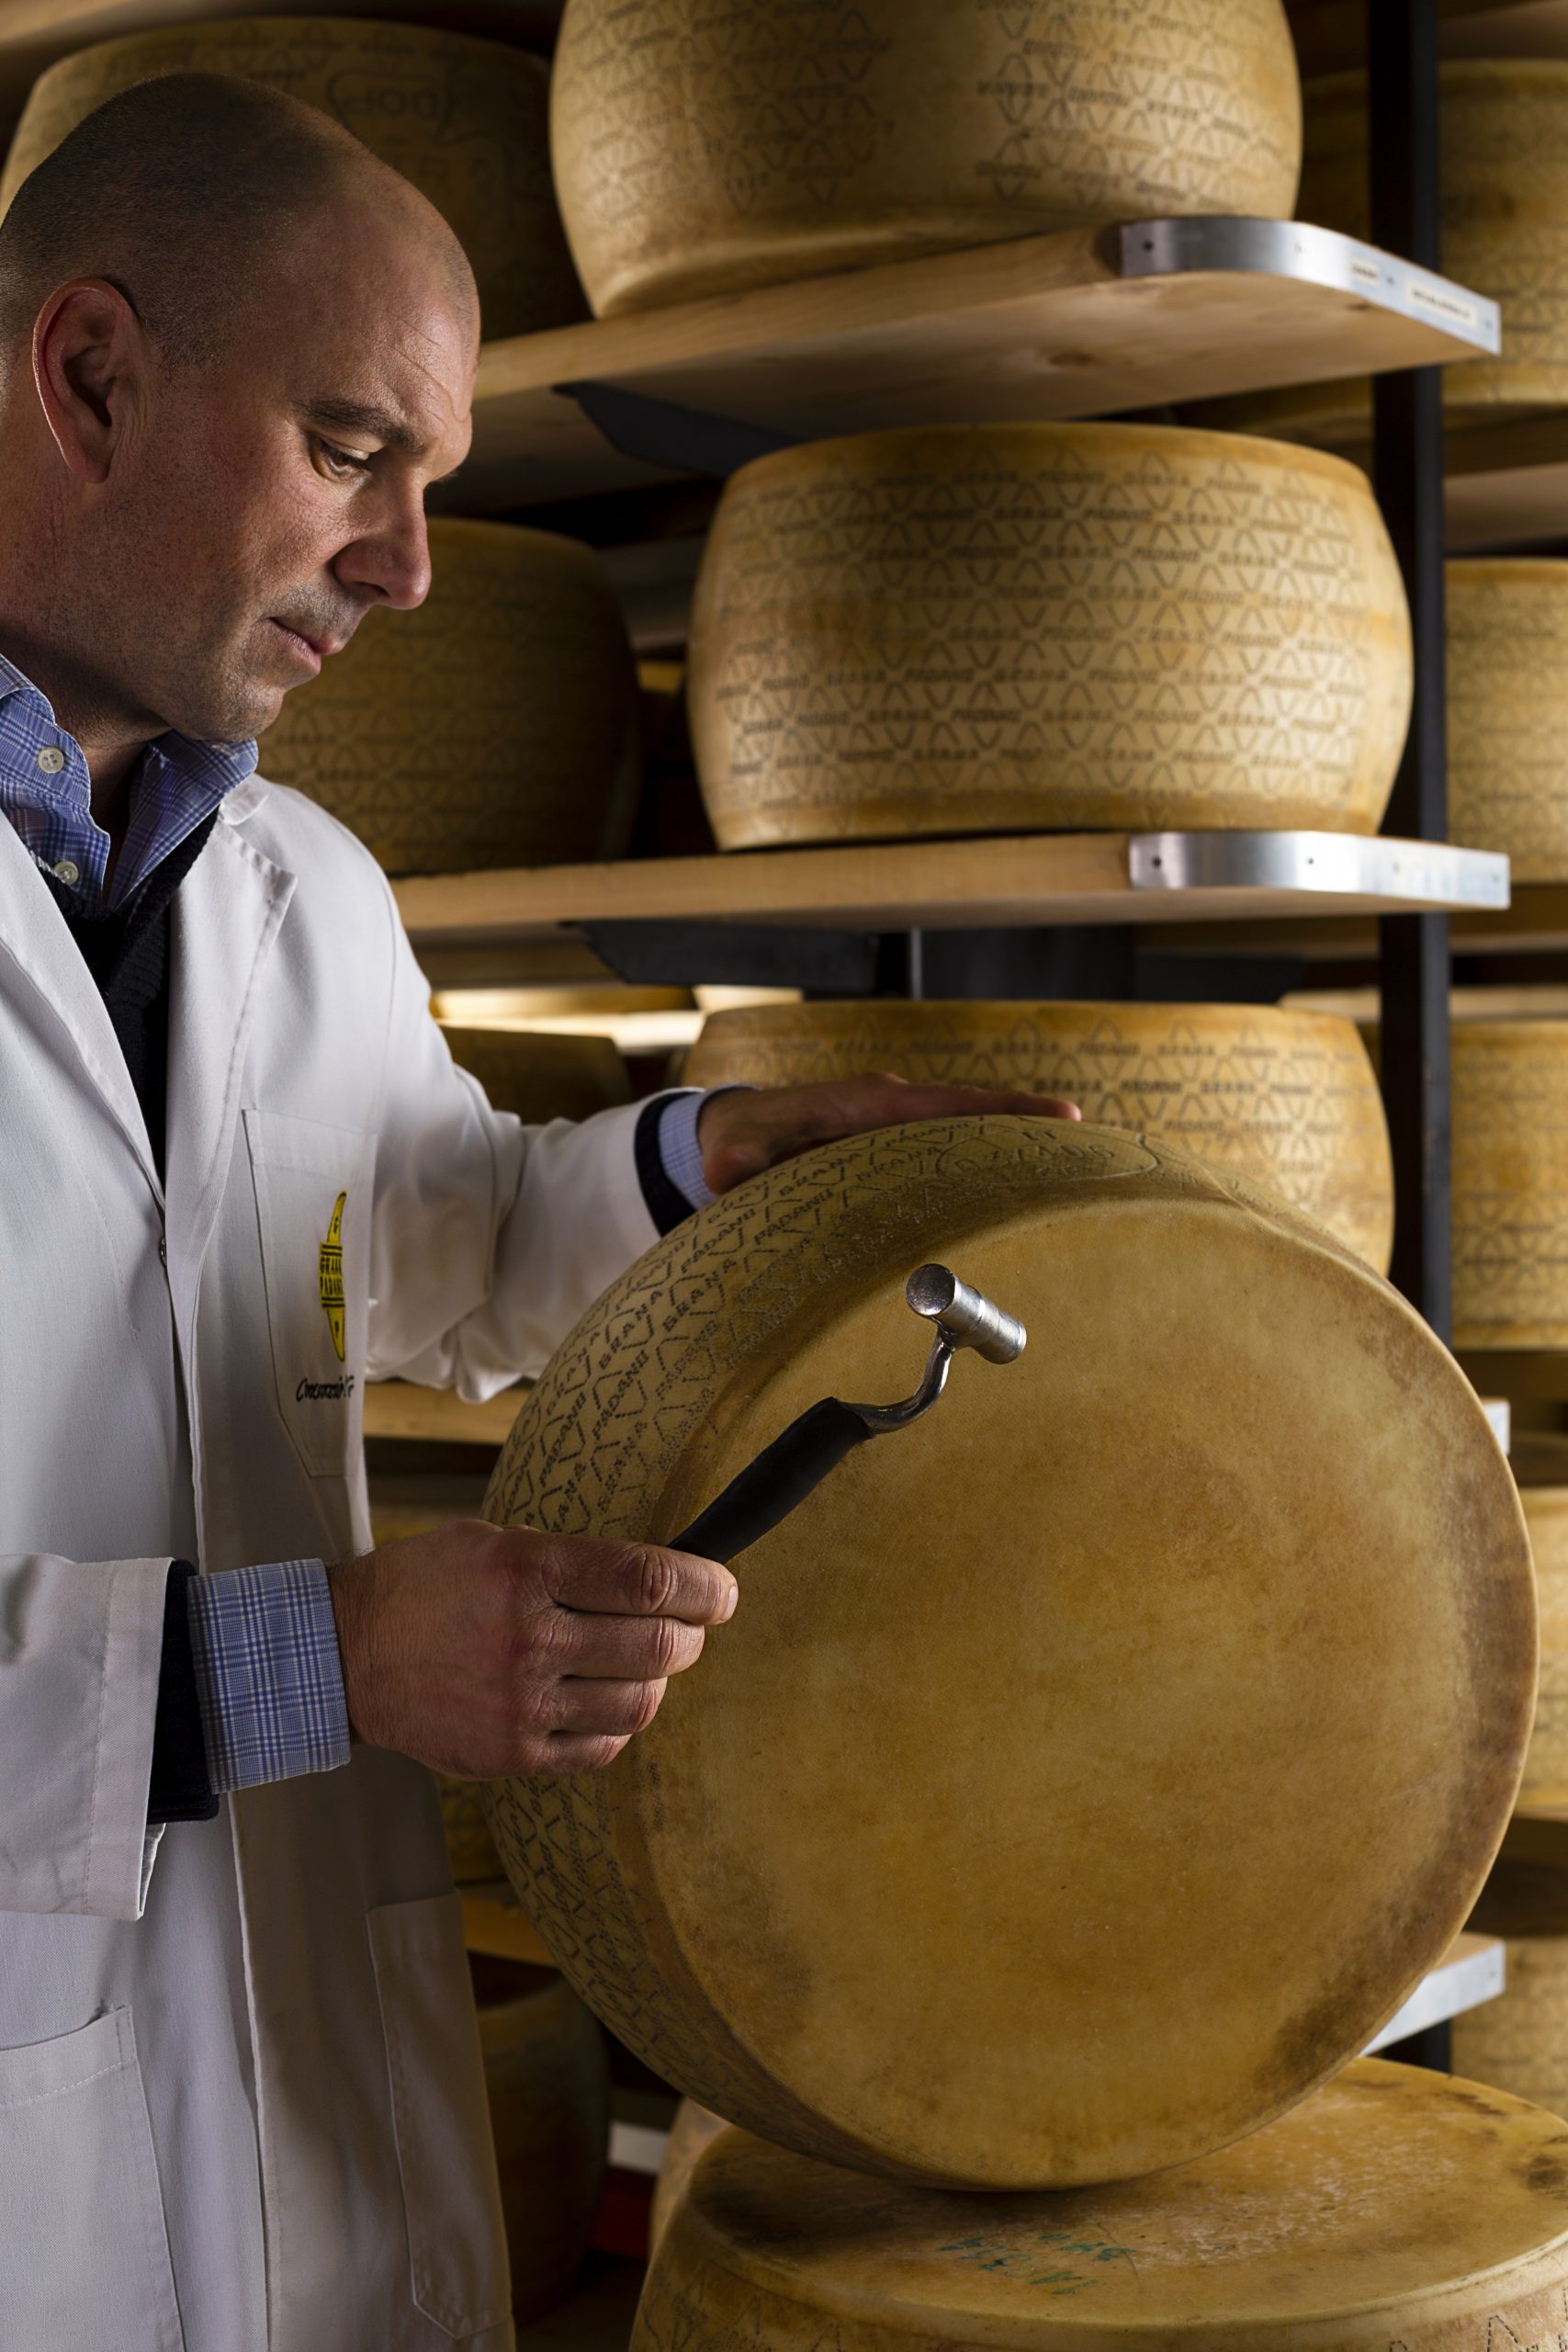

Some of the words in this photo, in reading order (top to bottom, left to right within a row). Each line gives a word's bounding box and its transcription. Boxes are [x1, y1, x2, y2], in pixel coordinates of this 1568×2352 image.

[539, 1391, 587, 1487] PADANO
[599, 1290, 663, 1370] GRANA
[681, 1207, 755, 1273] PADANO
[778, 1152, 863, 1196] GRANA
[551, 1461, 588, 1534] RANA
[592, 1350, 649, 1441] PADANO
[662, 1257, 738, 1332] GRANA
[753, 1187, 834, 1245] PADANO
